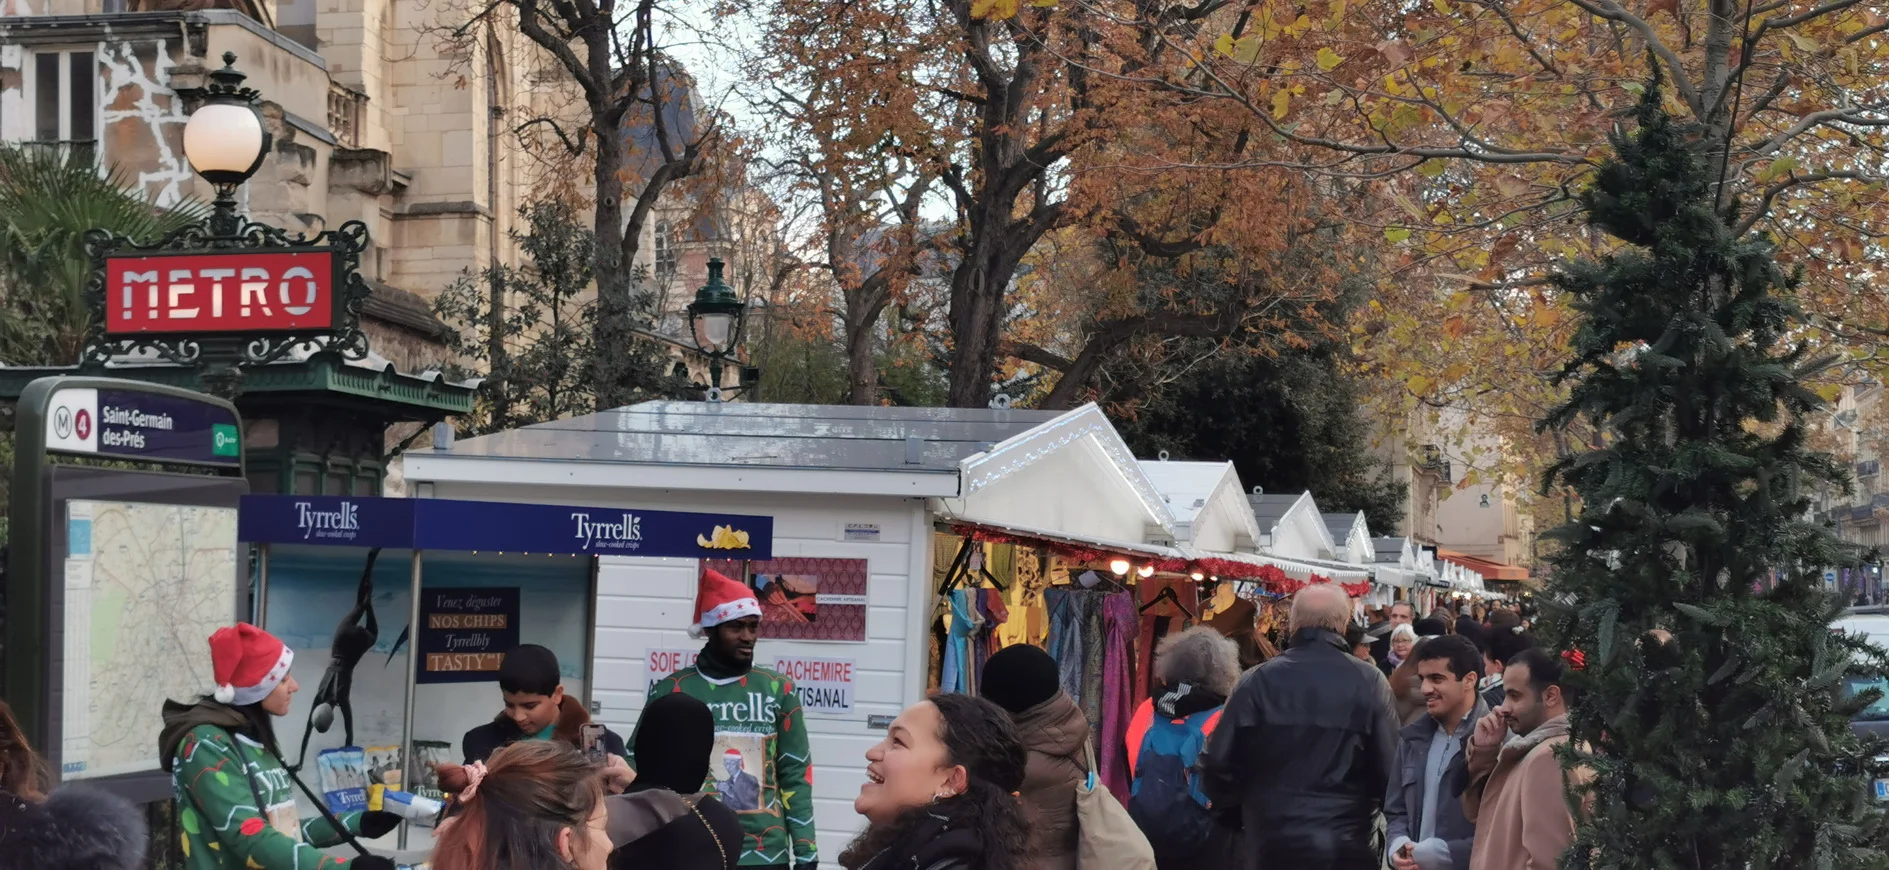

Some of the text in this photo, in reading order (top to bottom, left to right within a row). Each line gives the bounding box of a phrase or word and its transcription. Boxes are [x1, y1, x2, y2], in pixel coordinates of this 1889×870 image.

[122, 266, 318, 320] METRO
[102, 406, 174, 430] Saint-Germain
[102, 427, 146, 449] des-Prés
[436, 593, 502, 611] Venez déguster
[431, 614, 505, 629] NOS CHIPS
[445, 632, 491, 652] Tyrrellbly
[649, 651, 681, 673] SOIE
[776, 659, 852, 683] CACHEMIRE
[796, 687, 849, 708] TISANAL
